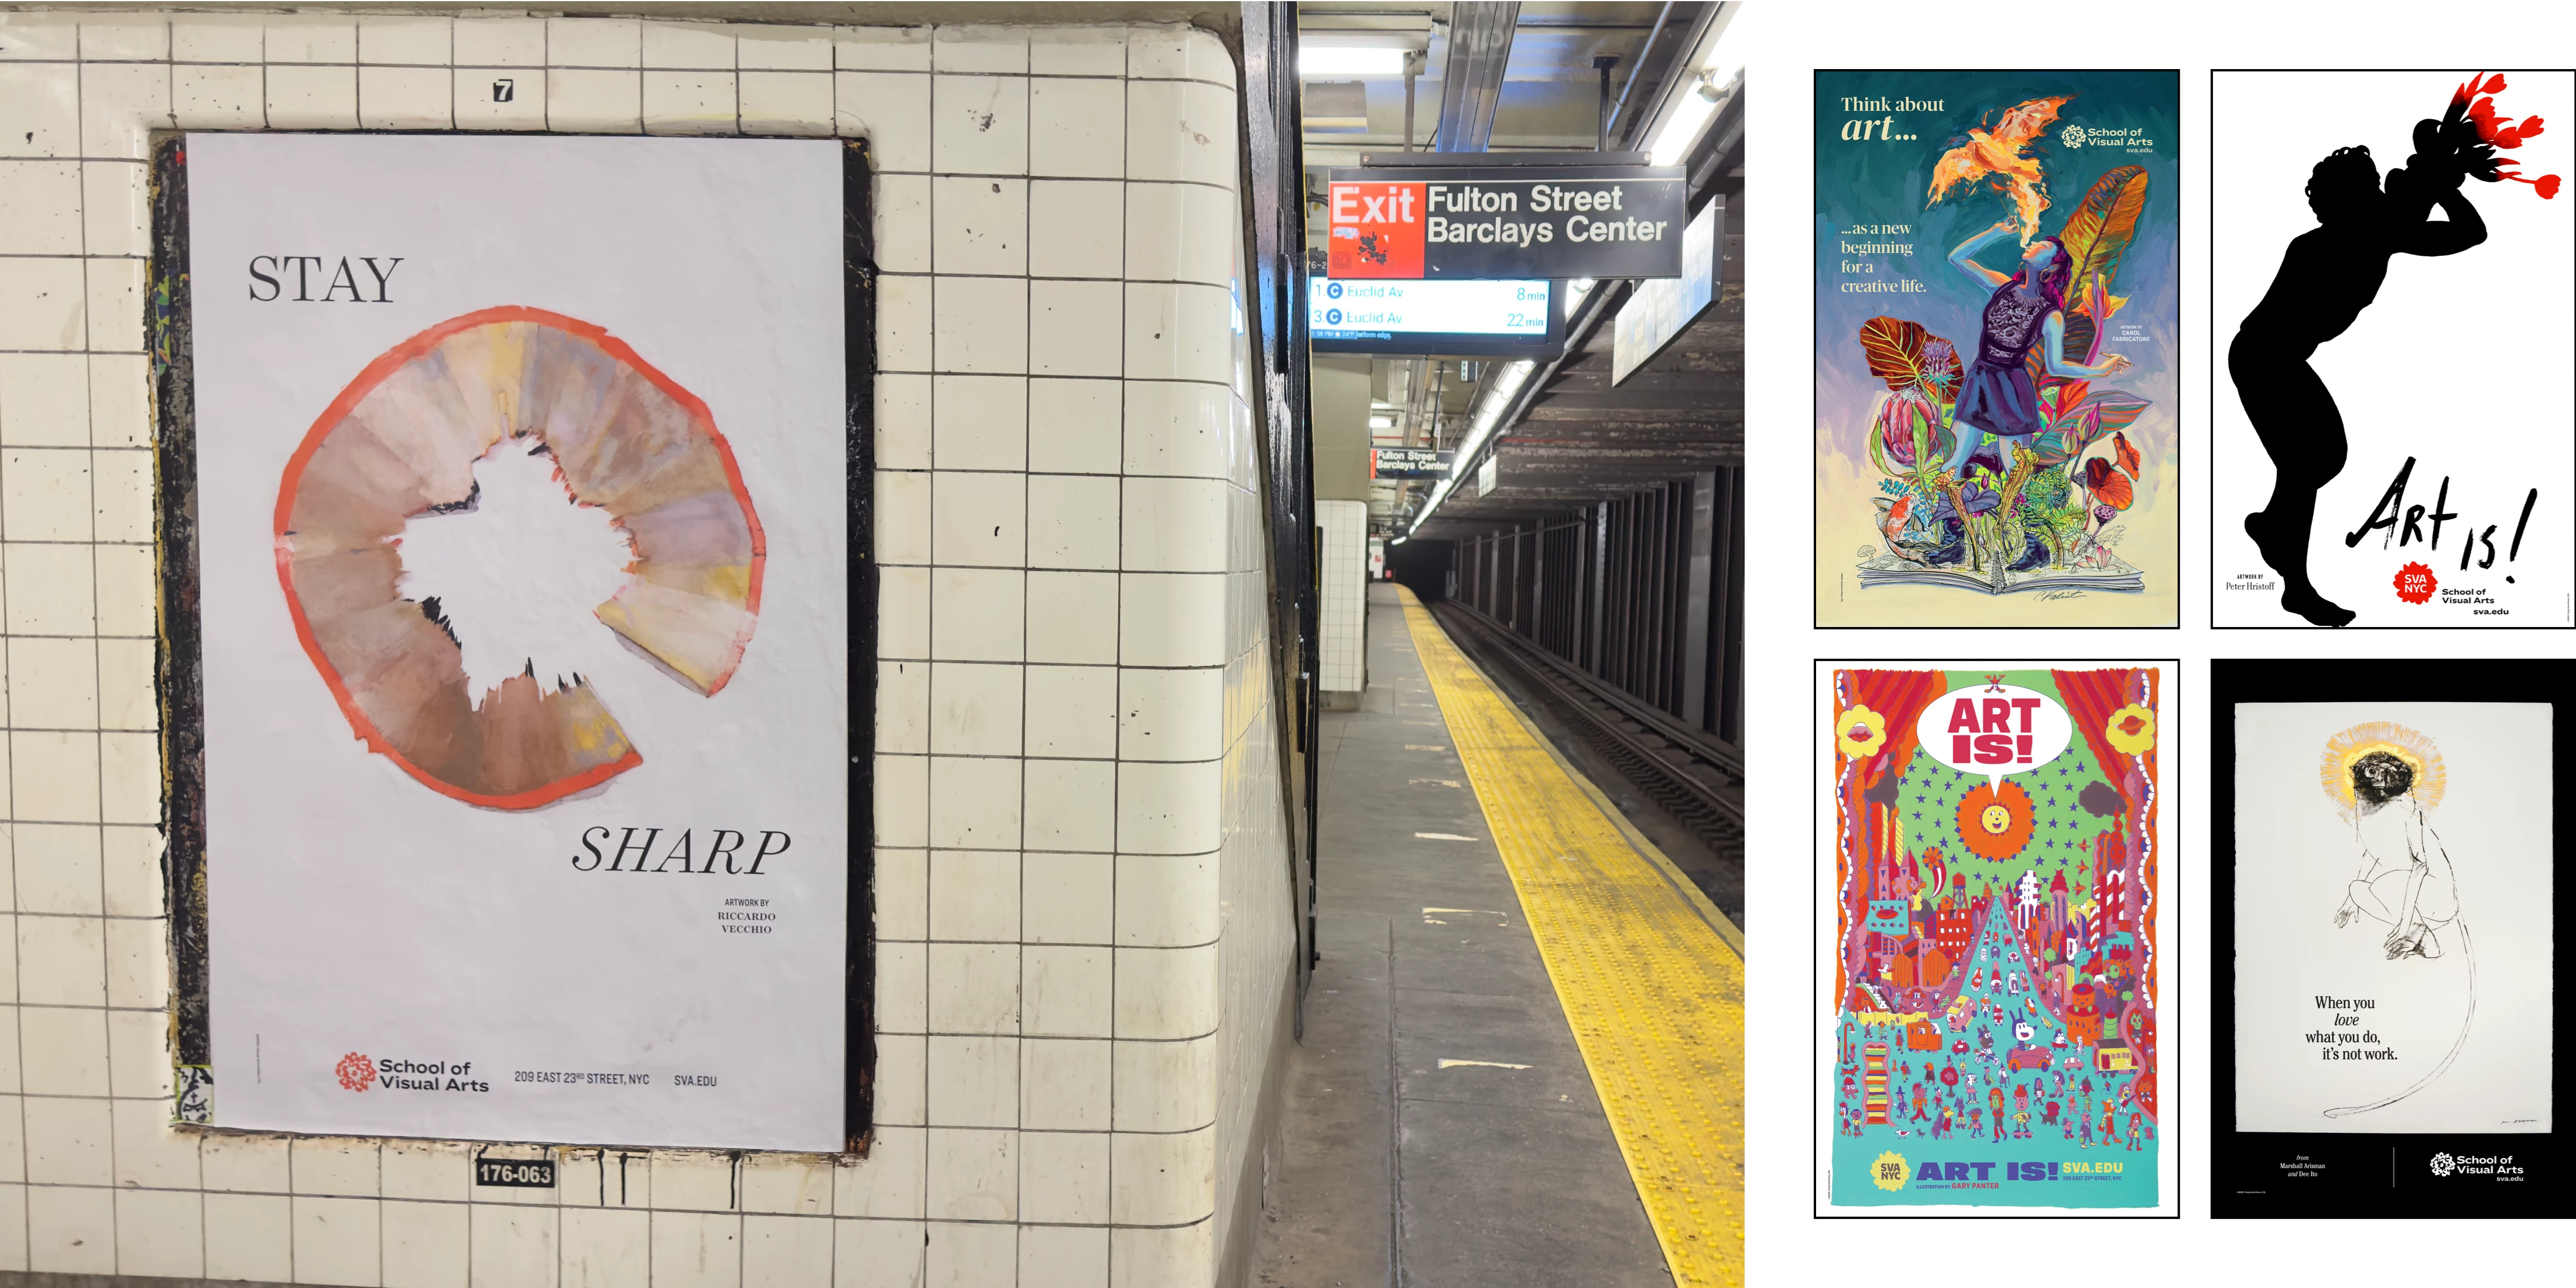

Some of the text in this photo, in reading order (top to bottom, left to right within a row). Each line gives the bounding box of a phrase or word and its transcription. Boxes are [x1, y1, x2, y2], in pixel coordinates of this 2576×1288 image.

[495, 81, 512, 100] 7
[1841, 97, 1944, 111] Think about
[1842, 116, 1917, 140] art...
[2088, 128, 2143, 136] School of
[2088, 138, 2153, 146] Visual Arts
[1332, 186, 1414, 224] Exit
[1427, 184, 1623, 213] Fulton Street
[1427, 217, 1667, 247] Barclays Center
[1871, 225, 1878, 234] a
[1882, 225, 1912, 234] new
[1842, 241, 1913, 256] beginning
[1842, 260, 1873, 273] for a
[249, 256, 404, 302] STAY
[1842, 279, 1926, 292] creative life.
[1348, 286, 1385, 297] Euclid
[1388, 287, 1404, 297] Av
[1517, 287, 1525, 300] 8
[1527, 292, 1545, 300] min
[1347, 311, 1383, 323] Euclid
[1387, 313, 1403, 324] Av
[1507, 313, 1524, 327] 22
[1526, 318, 1544, 327] min
[1376, 451, 1405, 460] Fulton
[1376, 460, 1450, 470] Barclays Center
[2226, 582, 2275, 590] Peter Hristoff
[2405, 574, 2427, 592] SVA NYC
[1948, 698, 2040, 733] ART
[1953, 734, 2032, 764] IS!
[573, 827, 790, 874] SHARP
[724, 898, 769, 907] ARTWORK BY
[718, 912, 775, 920] RICCARDO
[722, 925, 771, 933] VECCHIO
[2315, 996, 2375, 1012] When you
[2335, 1013, 2359, 1026] love
[2306, 1030, 2380, 1046] what you do,
[2343, 1049, 2362, 1060] not
[2365, 1047, 2397, 1060] work.
[380, 1059, 470, 1075] School of
[380, 1076, 488, 1092] Visual Arts
[515, 1071, 534, 1082] 209
[537, 1072, 561, 1083] EAST
[587, 1074, 626, 1085] STREET,
[629, 1074, 649, 1084] NYC
[675, 1075, 716, 1087] SVA.EDU
[2457, 1156, 2512, 1164] School of
[481, 1164, 550, 1183] 176-063
[1881, 1163, 1901, 1180] SVA NYC
[1916, 1162, 2058, 1181] ART IS!
[2063, 1162, 2123, 1173] SVA.EDU
[2457, 1165, 2524, 1174] Visual Arts
